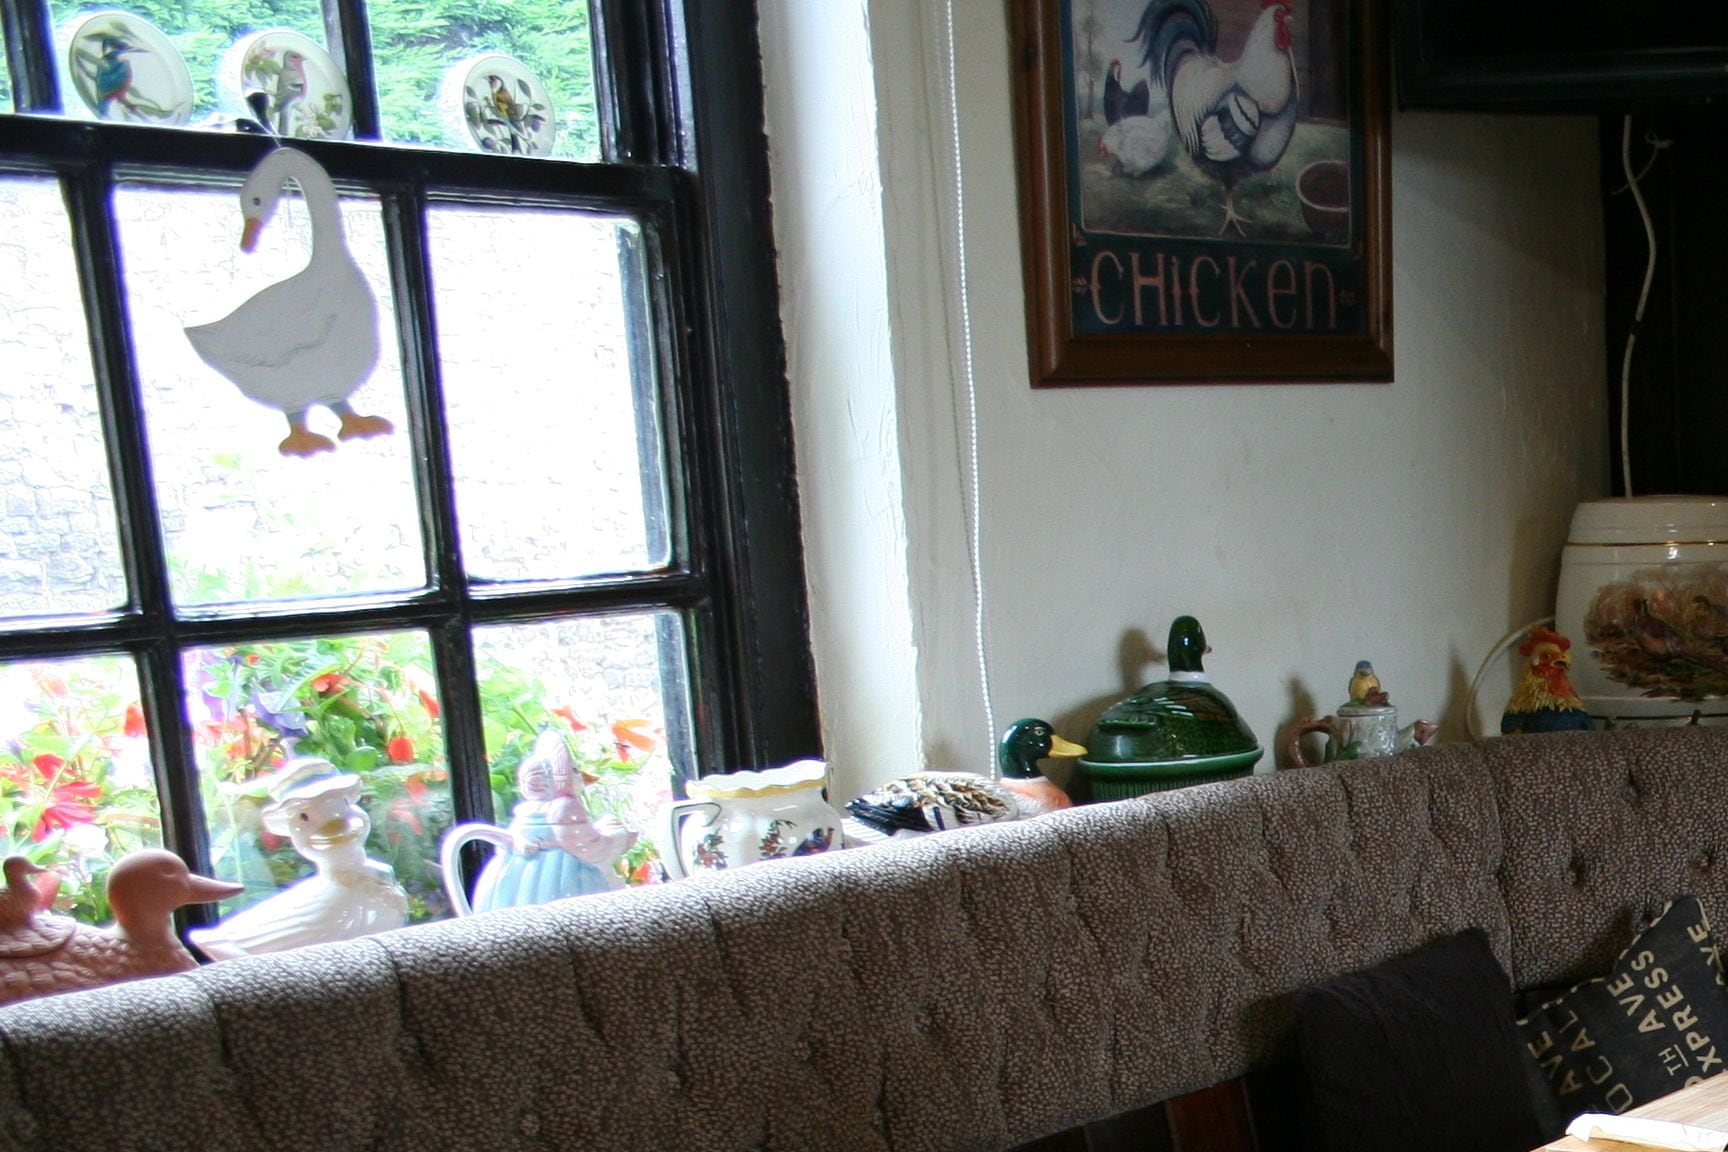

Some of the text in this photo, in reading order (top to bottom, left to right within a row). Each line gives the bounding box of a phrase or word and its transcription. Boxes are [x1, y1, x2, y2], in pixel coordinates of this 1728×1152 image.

[1606, 972, 1666, 1034] AVE
[1631, 950, 1724, 1074] XPRESS
[1527, 1030, 1584, 1096] AVE
[1558, 1009, 1634, 1113] OCAL
